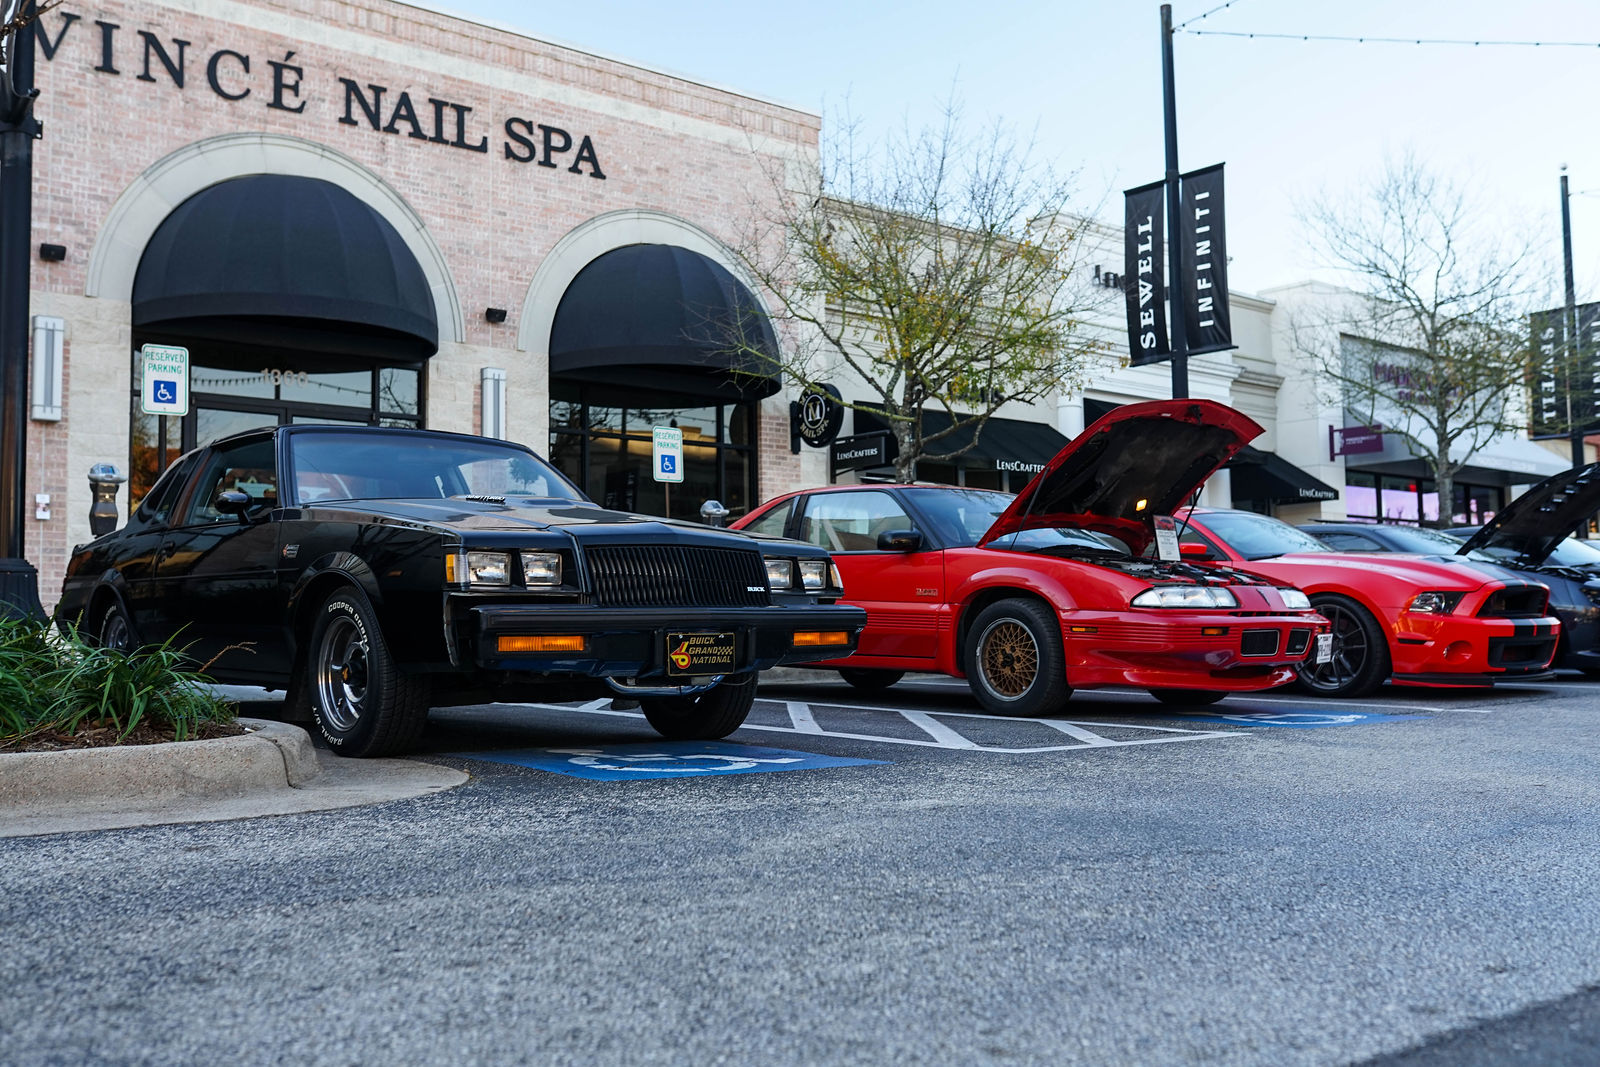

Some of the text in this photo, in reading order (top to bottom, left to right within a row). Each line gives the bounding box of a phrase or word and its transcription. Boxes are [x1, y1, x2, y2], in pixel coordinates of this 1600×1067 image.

[34, 12, 607, 179] VINCÉ NAIL SPA
[1195, 191, 1214, 328] INFINITI
[1138, 215, 1157, 349] SEWELL
[145, 351, 185, 364] RESERVED
[148, 364, 183, 375] PARKING
[655, 431, 681, 441] RESERVED
[657, 441, 680, 450] PARKING
[328, 601, 354, 615] COOPER
[689, 636, 716, 645] BUICK
[688, 646, 718, 655] GRAND
[691, 655, 732, 665] NATIONAL
